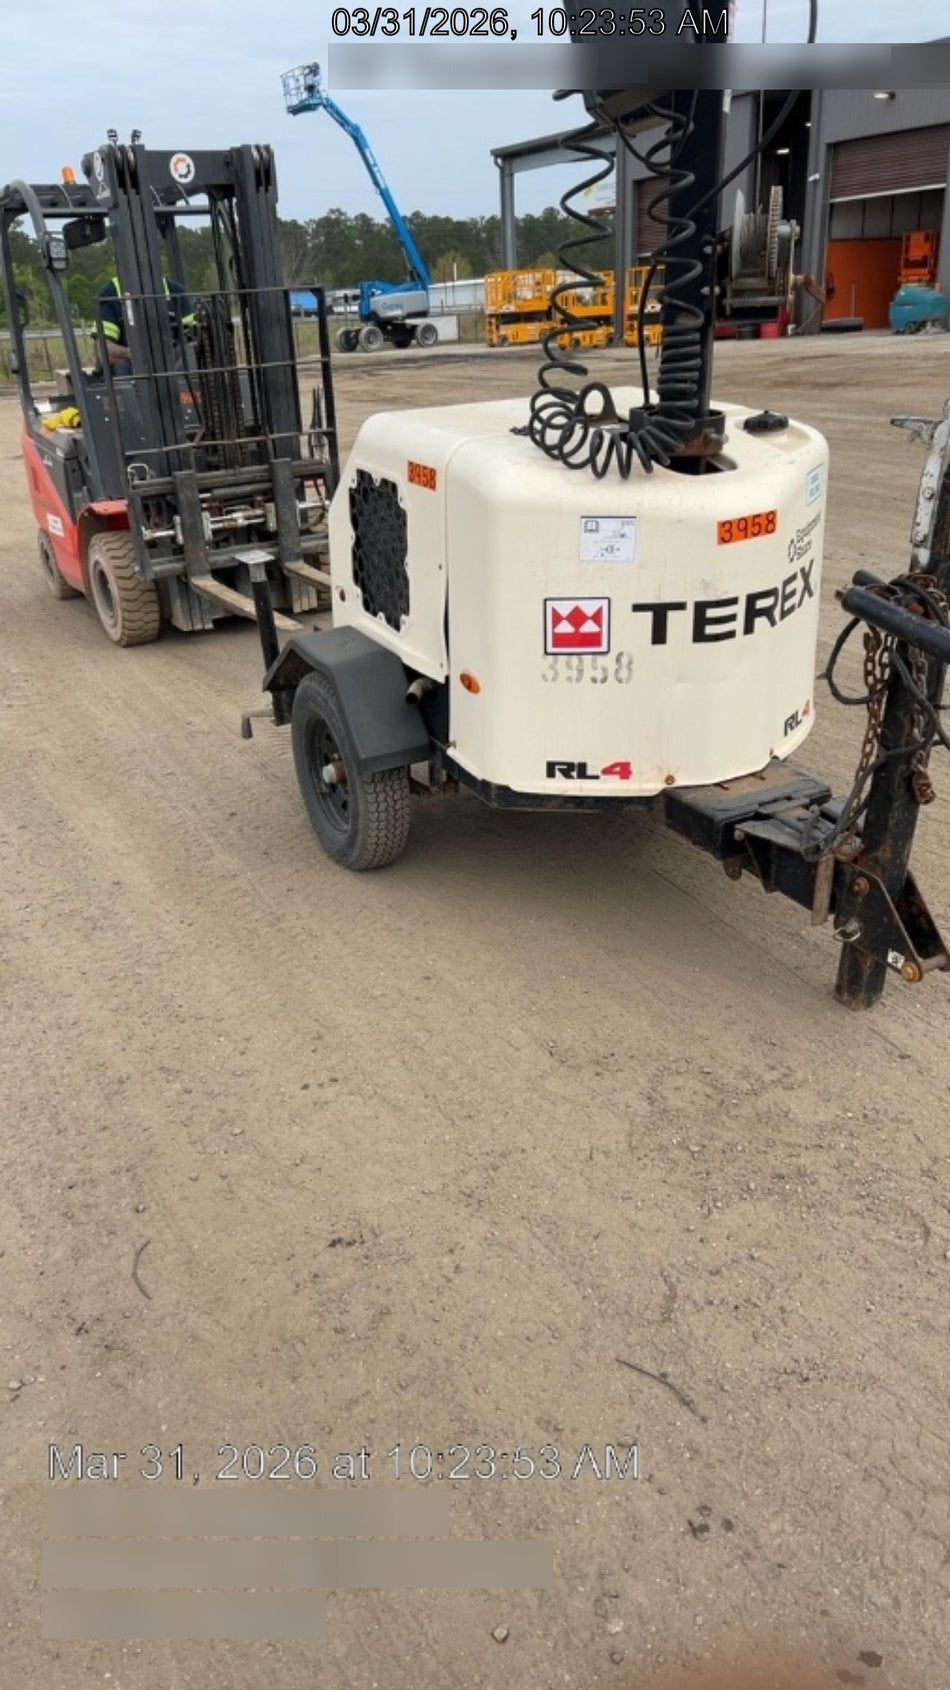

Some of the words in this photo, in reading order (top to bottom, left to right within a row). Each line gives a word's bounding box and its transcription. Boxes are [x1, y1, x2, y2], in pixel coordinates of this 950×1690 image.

[720, 511, 777, 543] 3958
[632, 559, 815, 645] TEREX
[541, 651, 634, 684] 3958
[784, 700, 810, 736] RL4
[546, 761, 632, 780] RL4
